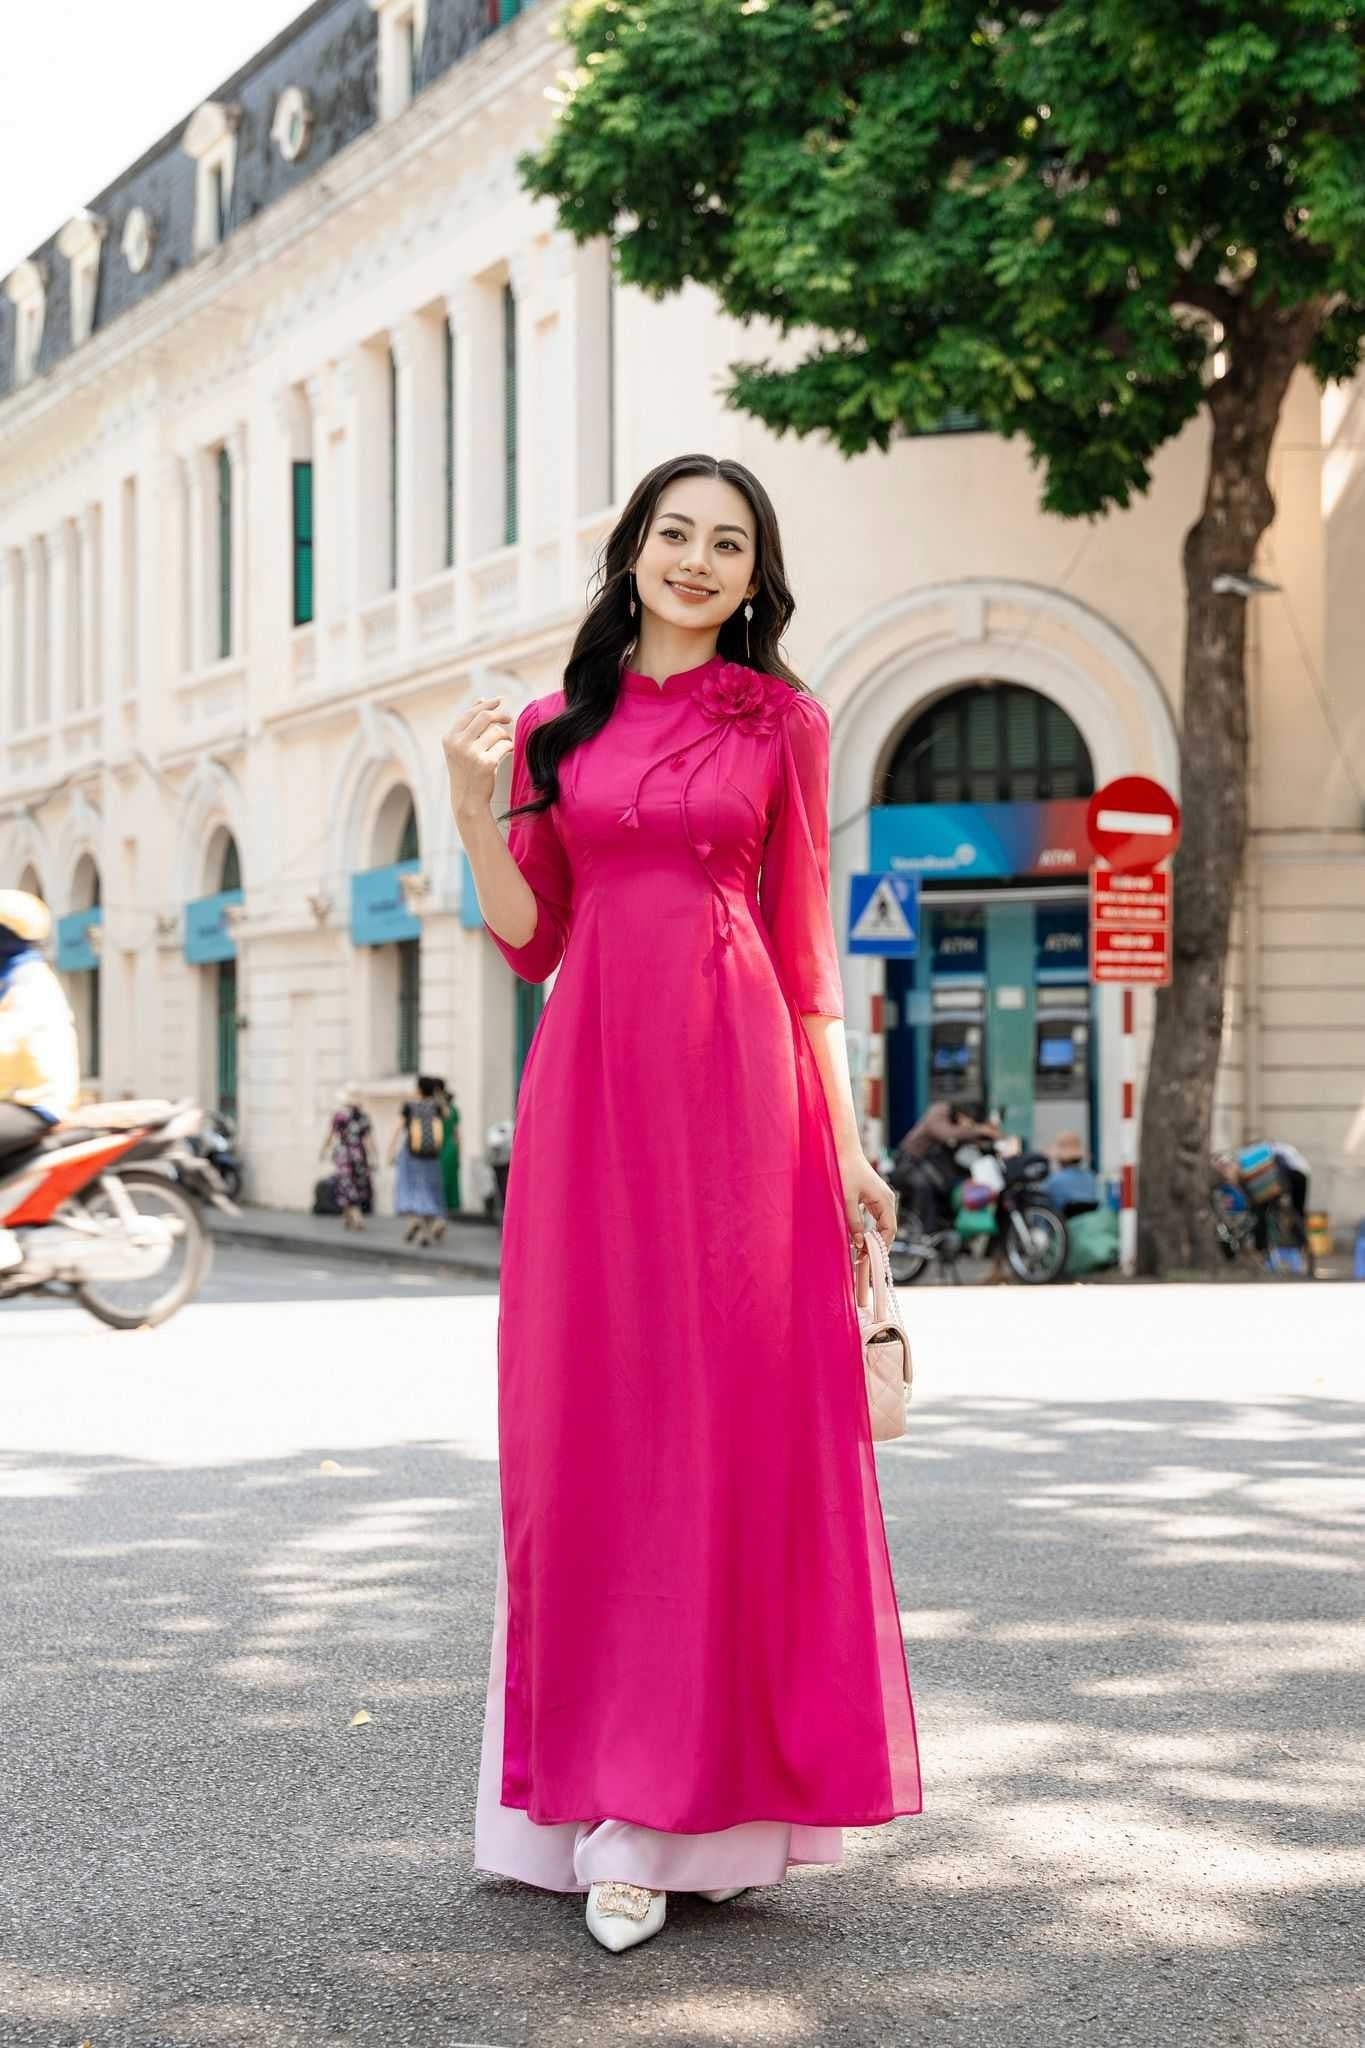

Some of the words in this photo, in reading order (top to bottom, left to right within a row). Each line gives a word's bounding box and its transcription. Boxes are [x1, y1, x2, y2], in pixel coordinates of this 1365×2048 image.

[1039, 849, 1077, 866] ATM
[940, 937, 978, 955] ATM
[1045, 934, 1083, 952] ATM
